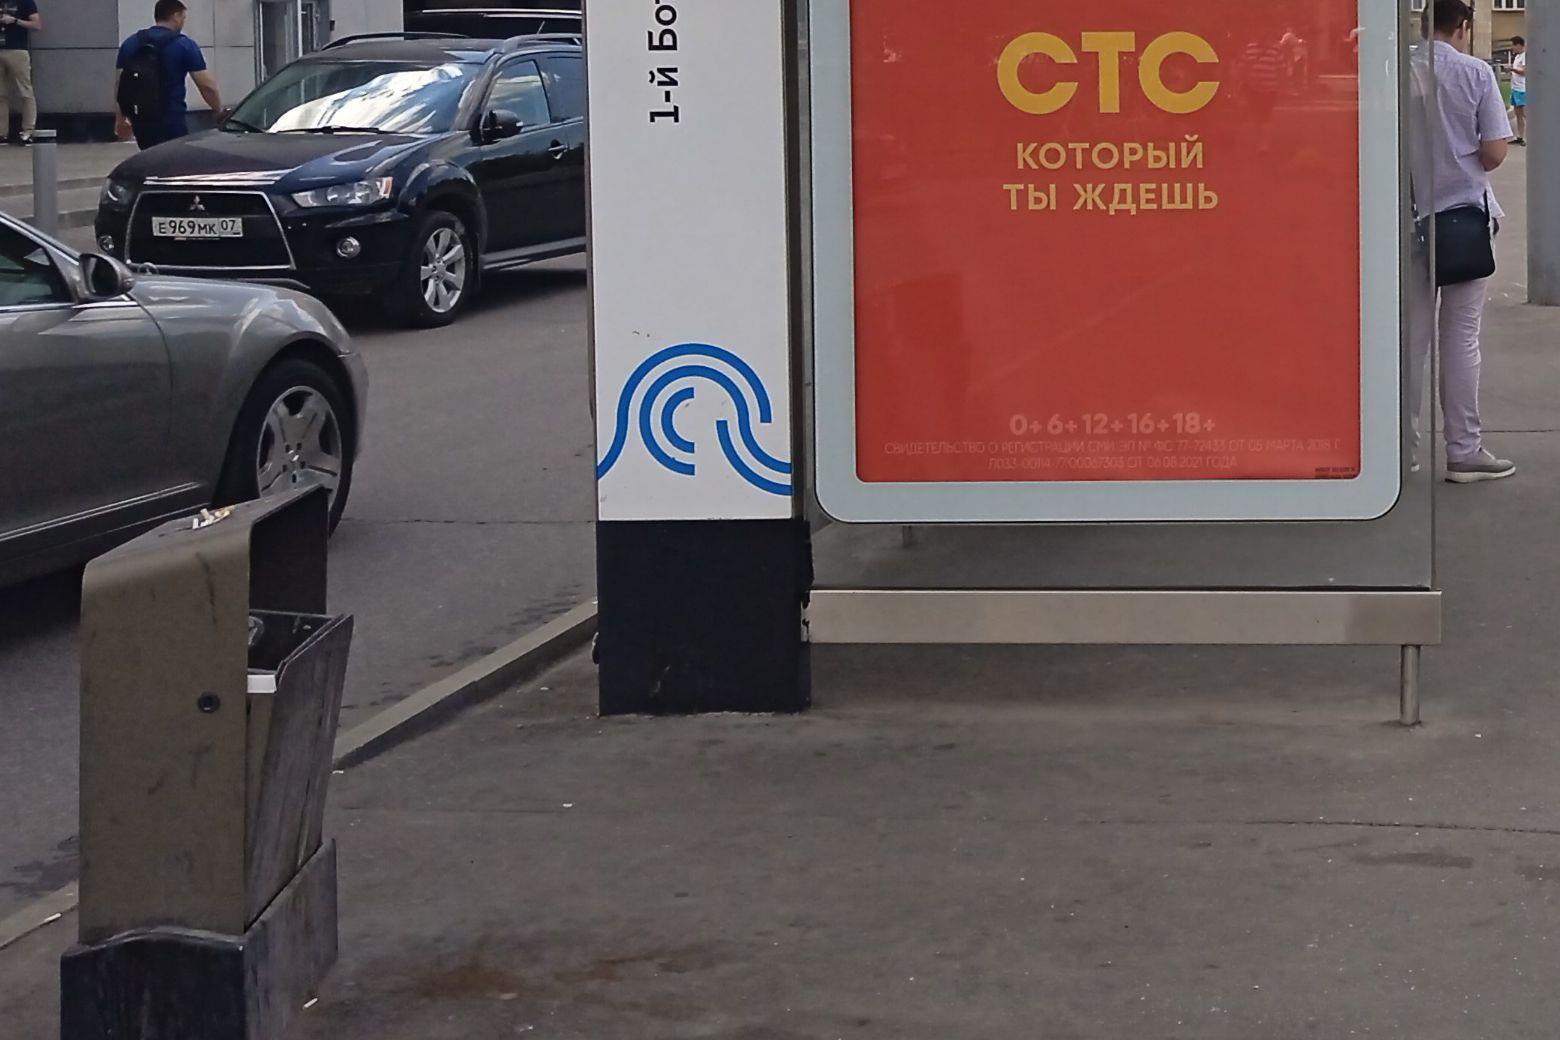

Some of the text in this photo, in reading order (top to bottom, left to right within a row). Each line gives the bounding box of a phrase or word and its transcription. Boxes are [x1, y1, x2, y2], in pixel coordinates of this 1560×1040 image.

[649, 66, 680, 123] 1-й
[997, 32, 1220, 114] СТС
[1016, 134, 1203, 169] КОТОРЫЙ
[1003, 183, 1218, 215] ТЫ ЖДЕШЬ
